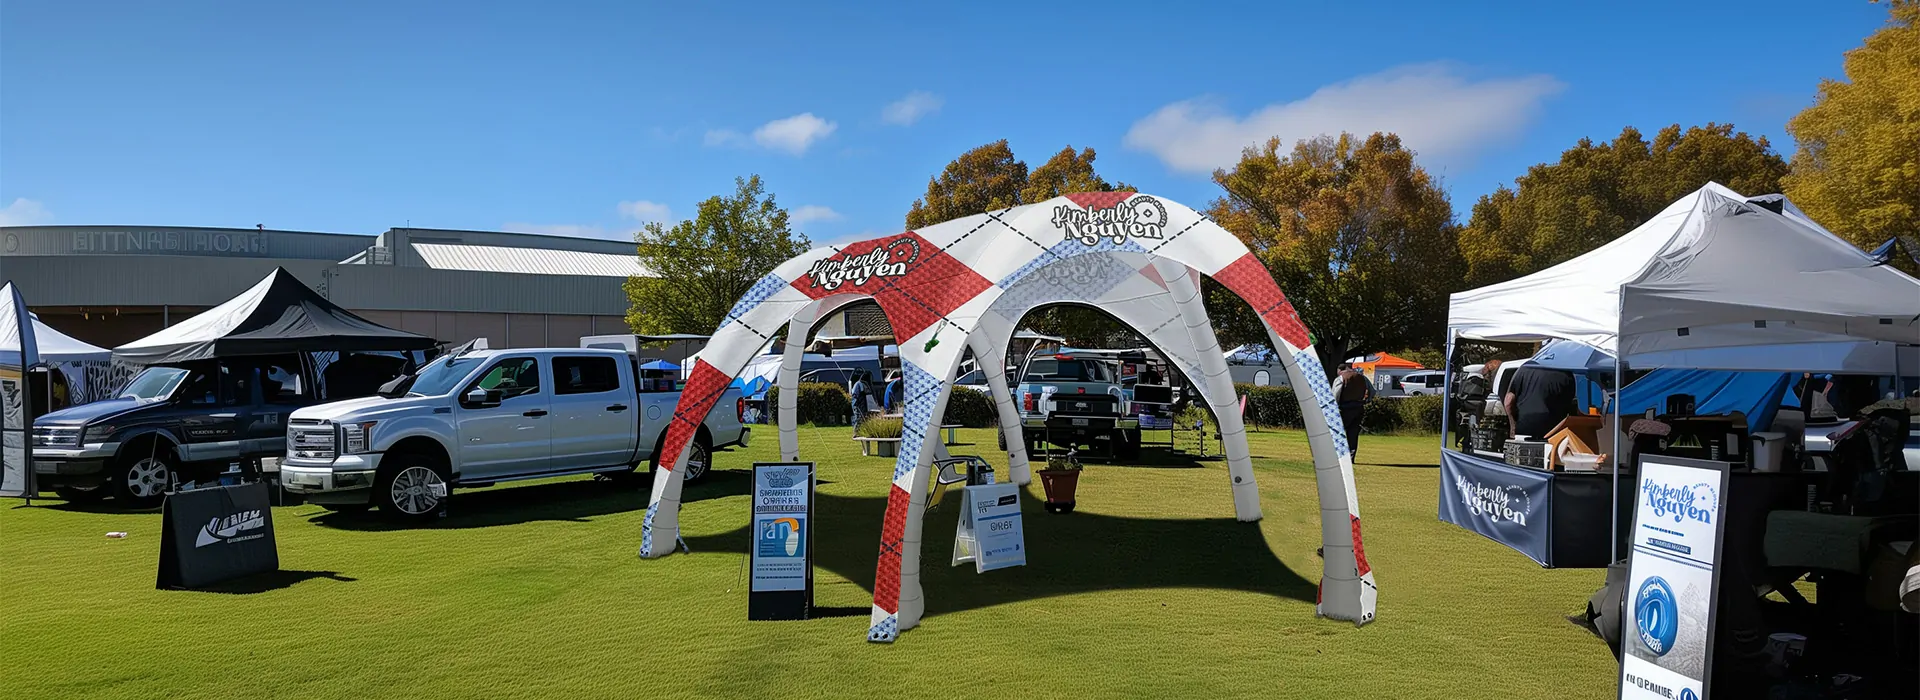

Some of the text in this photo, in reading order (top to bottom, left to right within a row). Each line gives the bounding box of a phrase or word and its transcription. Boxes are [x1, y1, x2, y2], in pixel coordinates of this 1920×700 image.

[1052, 202, 1138, 228] Kimberly
[1065, 222, 1163, 246] Nguyen
[808, 247, 890, 278] Kimberly
[811, 262, 906, 290] Nguyen
[1456, 475, 1509, 508] Kimberly
[1642, 478, 1695, 508] Kimberly
[1462, 489, 1527, 526] Nguyen
[1646, 492, 1711, 524] Nguyen
